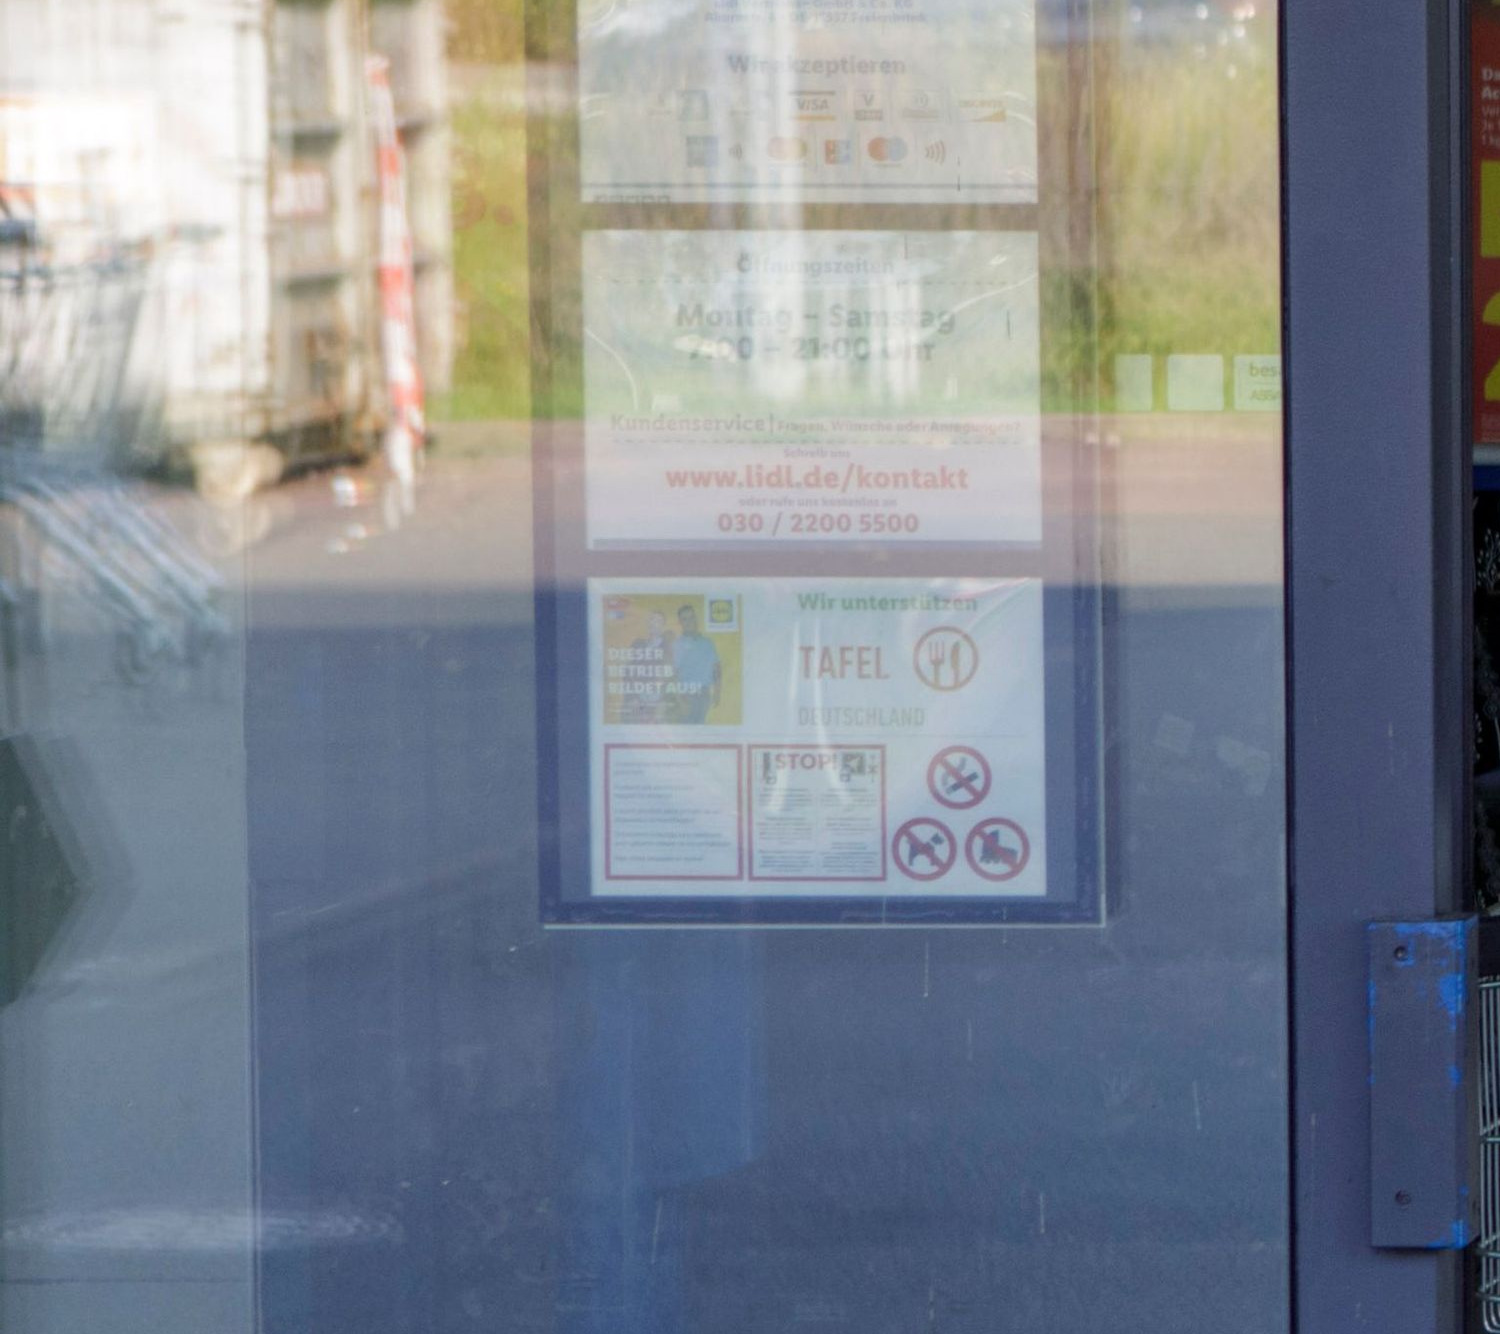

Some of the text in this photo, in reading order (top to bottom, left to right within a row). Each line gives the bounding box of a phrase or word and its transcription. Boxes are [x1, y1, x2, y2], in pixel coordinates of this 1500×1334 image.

[779, 54, 906, 79] kzeptieren
[795, 98, 829, 112] VISA
[611, 414, 766, 434] Kundenservice
[665, 463, 969, 492] www.lidl.de/kontakt
[717, 512, 765, 535] 030
[789, 512, 852, 535] 2200
[858, 512, 919, 535] 5500
[797, 591, 979, 614] Wir unterstützen
[798, 645, 891, 681] TAFEL
[798, 705, 926, 728] DEUTSCHLAND
[775, 751, 838, 771] STOP!
